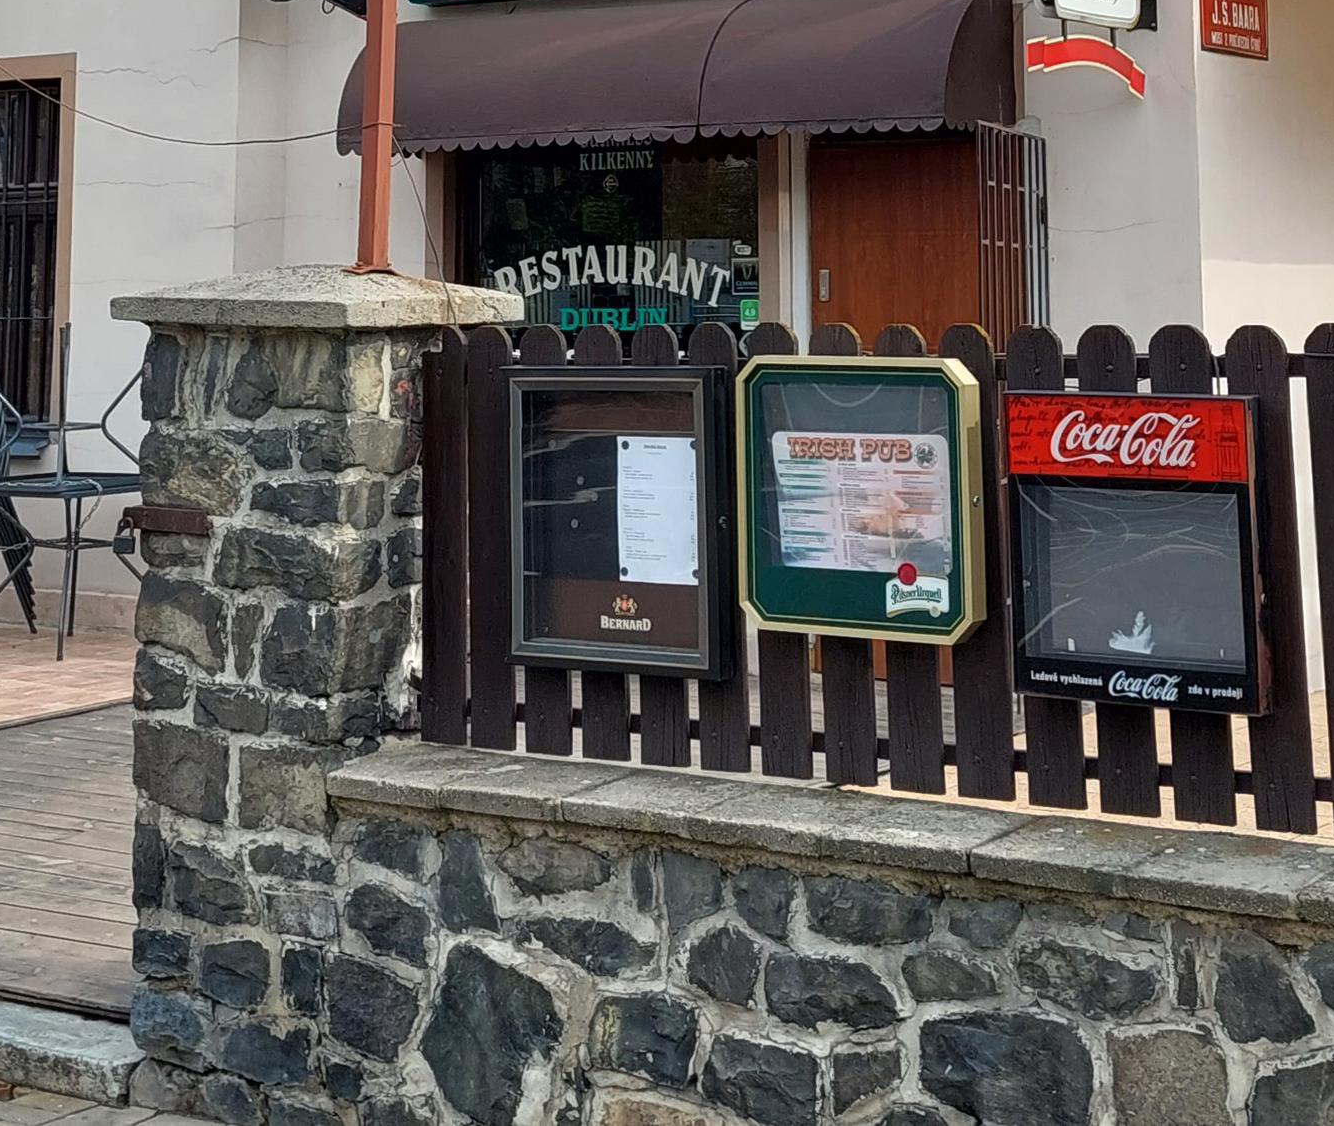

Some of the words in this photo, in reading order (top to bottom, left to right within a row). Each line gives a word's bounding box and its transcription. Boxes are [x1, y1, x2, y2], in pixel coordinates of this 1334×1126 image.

[1232, 2, 1260, 32] BAARA
[579, 150, 654, 171] KILKENNY
[494, 245, 730, 307] RESTAURANT
[559, 307, 667, 331] DUBLIN
[787, 437, 855, 461] IRISH
[860, 438, 913, 463] PUB
[1050, 410, 1200, 468] Coca-Cola
[891, 584, 917, 605] Pilsner
[917, 585, 942, 602] Urquell
[600, 615, 651, 632] BERNARD
[1108, 670, 1182, 702] Coca-Cola
[1187, 685, 1203, 695] zde
[1212, 686, 1243, 700] prodeji
